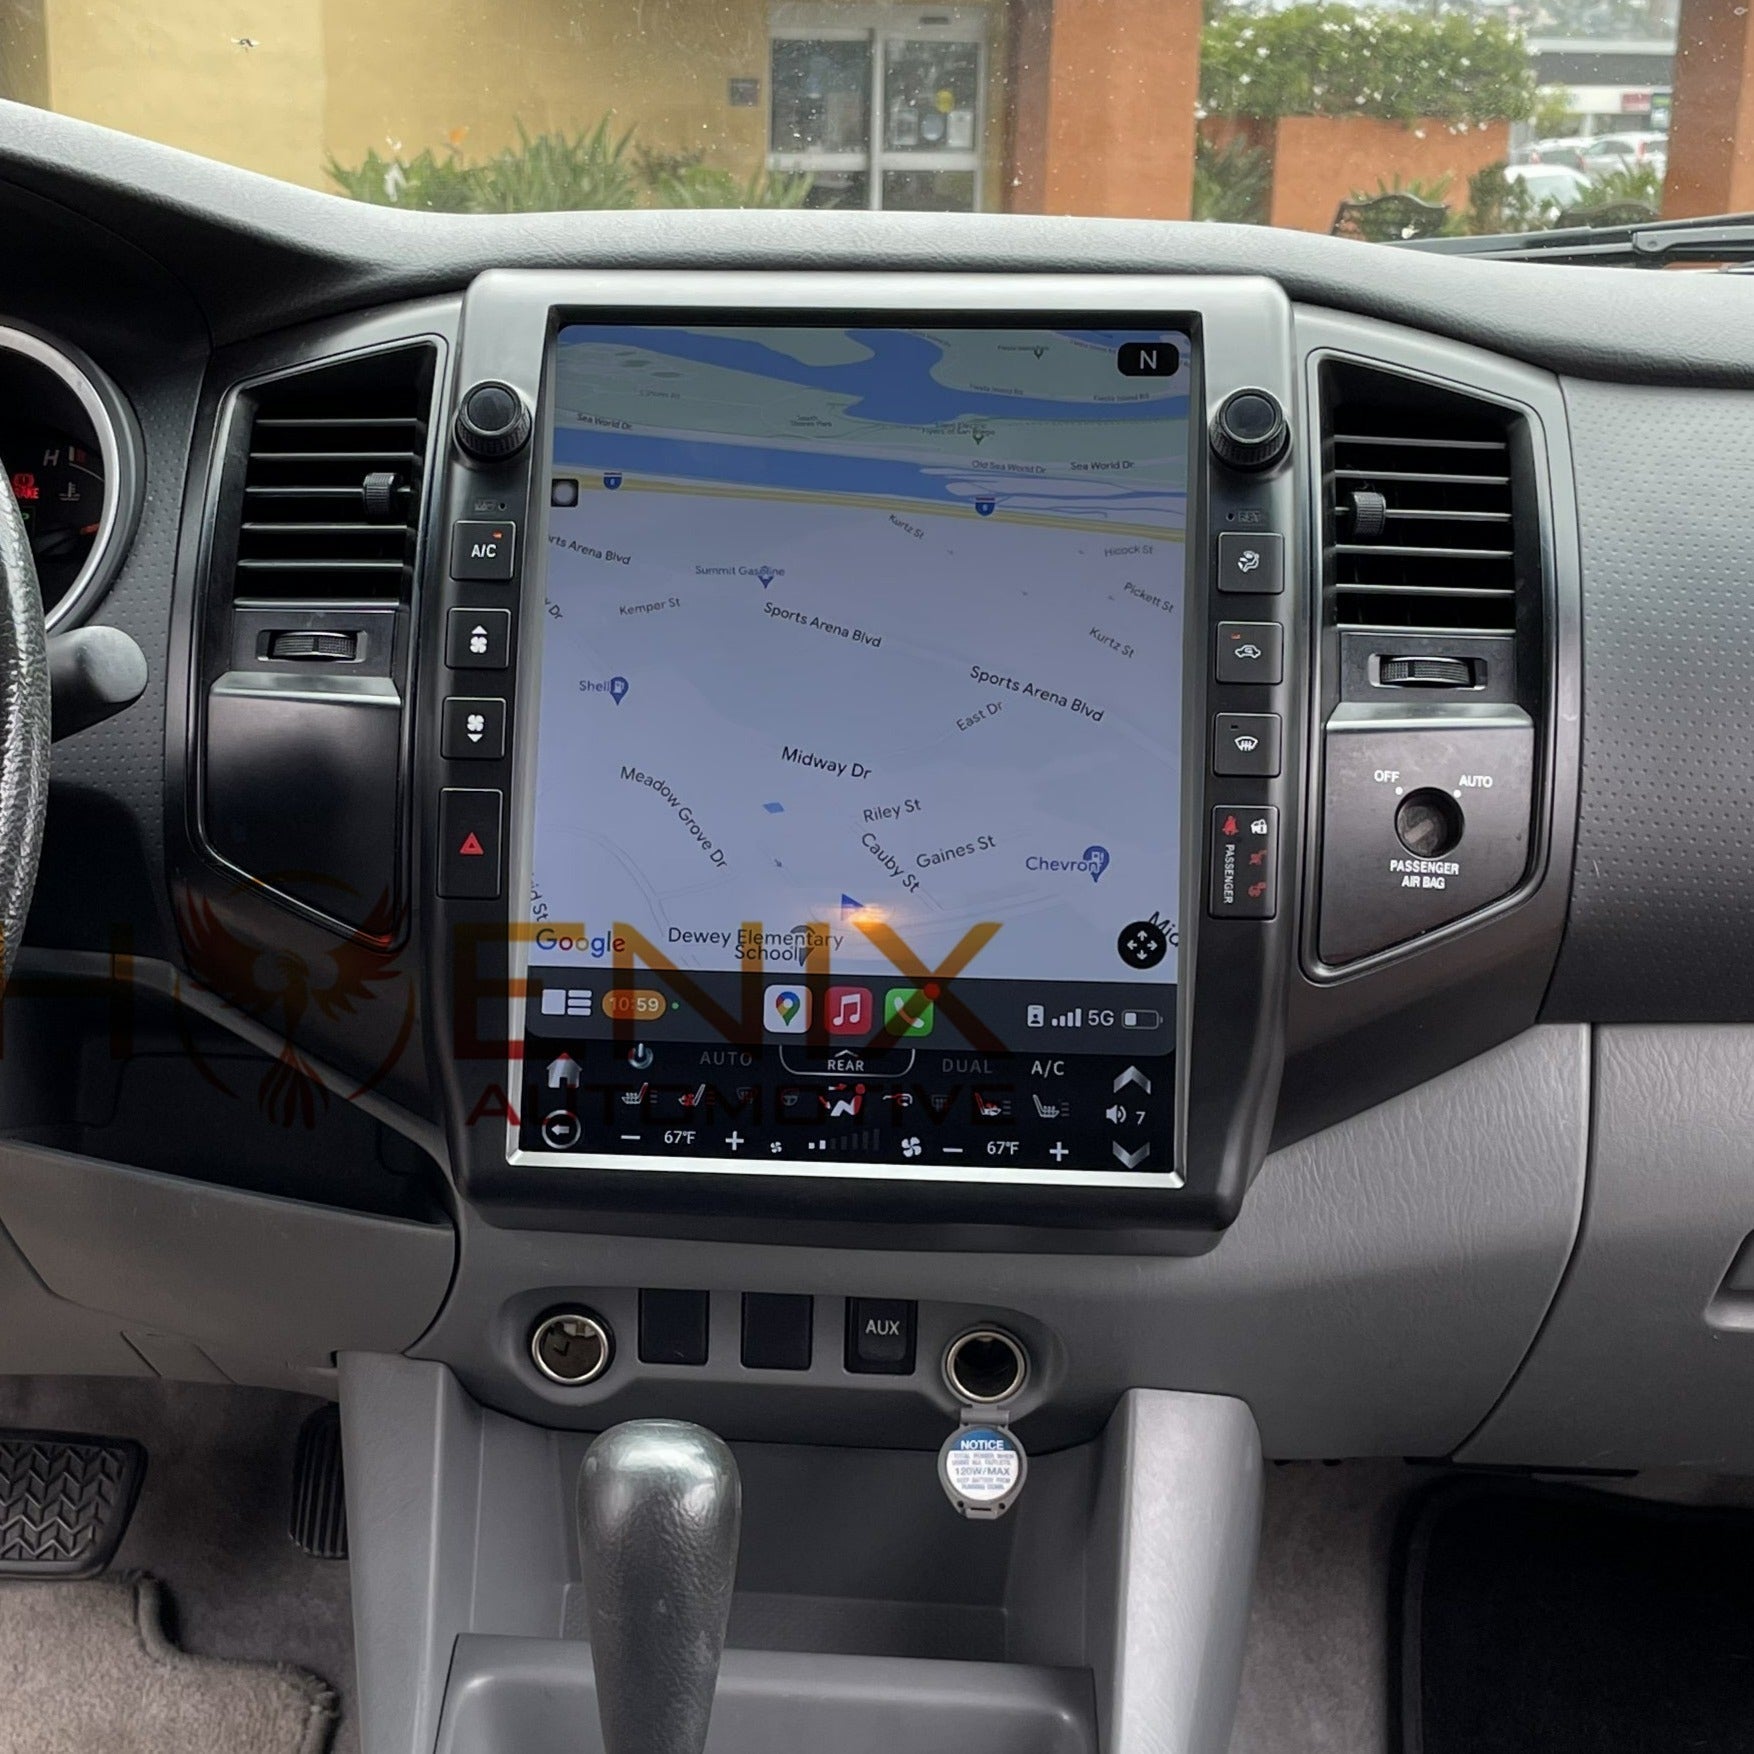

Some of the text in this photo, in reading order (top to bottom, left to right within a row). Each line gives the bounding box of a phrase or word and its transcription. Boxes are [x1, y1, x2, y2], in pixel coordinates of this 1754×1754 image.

[1140, 350, 1157, 370] N
[576, 412, 593, 423] Sea
[594, 417, 620, 430] World
[1070, 460, 1135, 471] Sea World Dr
[888, 513, 926, 540] Kurtz St
[471, 543, 497, 558] A/C
[567, 540, 603, 560] Arena
[605, 550, 632, 565] Blvd
[695, 565, 736, 576] Summit
[548, 604, 563, 620] Dr
[619, 597, 681, 617] Kemper St
[1161, 601, 1175, 614] St
[764, 601, 883, 649] Sports Arena Blvd
[1089, 626, 1135, 659] Kurtz St
[579, 679, 610, 692] Shell
[970, 665, 1105, 724] Sports Arena Blvd
[956, 701, 1005, 732] East Dr
[781, 746, 873, 780] Midway Dr
[1374, 769, 1400, 783] OFF
[1459, 774, 1493, 788] AUTO
[620, 765, 729, 870] Meadow Grove Dr
[863, 799, 922, 824] Riley St
[915, 834, 997, 870] Gaines St
[861, 832, 921, 894] Cauby St
[1025, 855, 1099, 873] Chevron
[1390, 859, 1460, 875] PASSENGER
[1223, 843, 1236, 905] PASSENGER
[1401, 875, 1446, 889] AIR BAG
[536, 927, 625, 957] Google
[668, 927, 844, 950] Dewey Elementary
[734, 944, 799, 961] School
[609, 996, 660, 1012] 10:59
[1088, 1010, 1114, 1026] 5G
[699, 1050, 752, 1067] AUTO
[827, 1059, 865, 1073] REAR
[942, 1057, 994, 1074] DUAL
[1031, 1060, 1065, 1077] A/C
[1135, 1110, 1146, 1125] 7
[865, 1319, 900, 1336] AUX
[960, 1439, 1005, 1451] NOTICE
